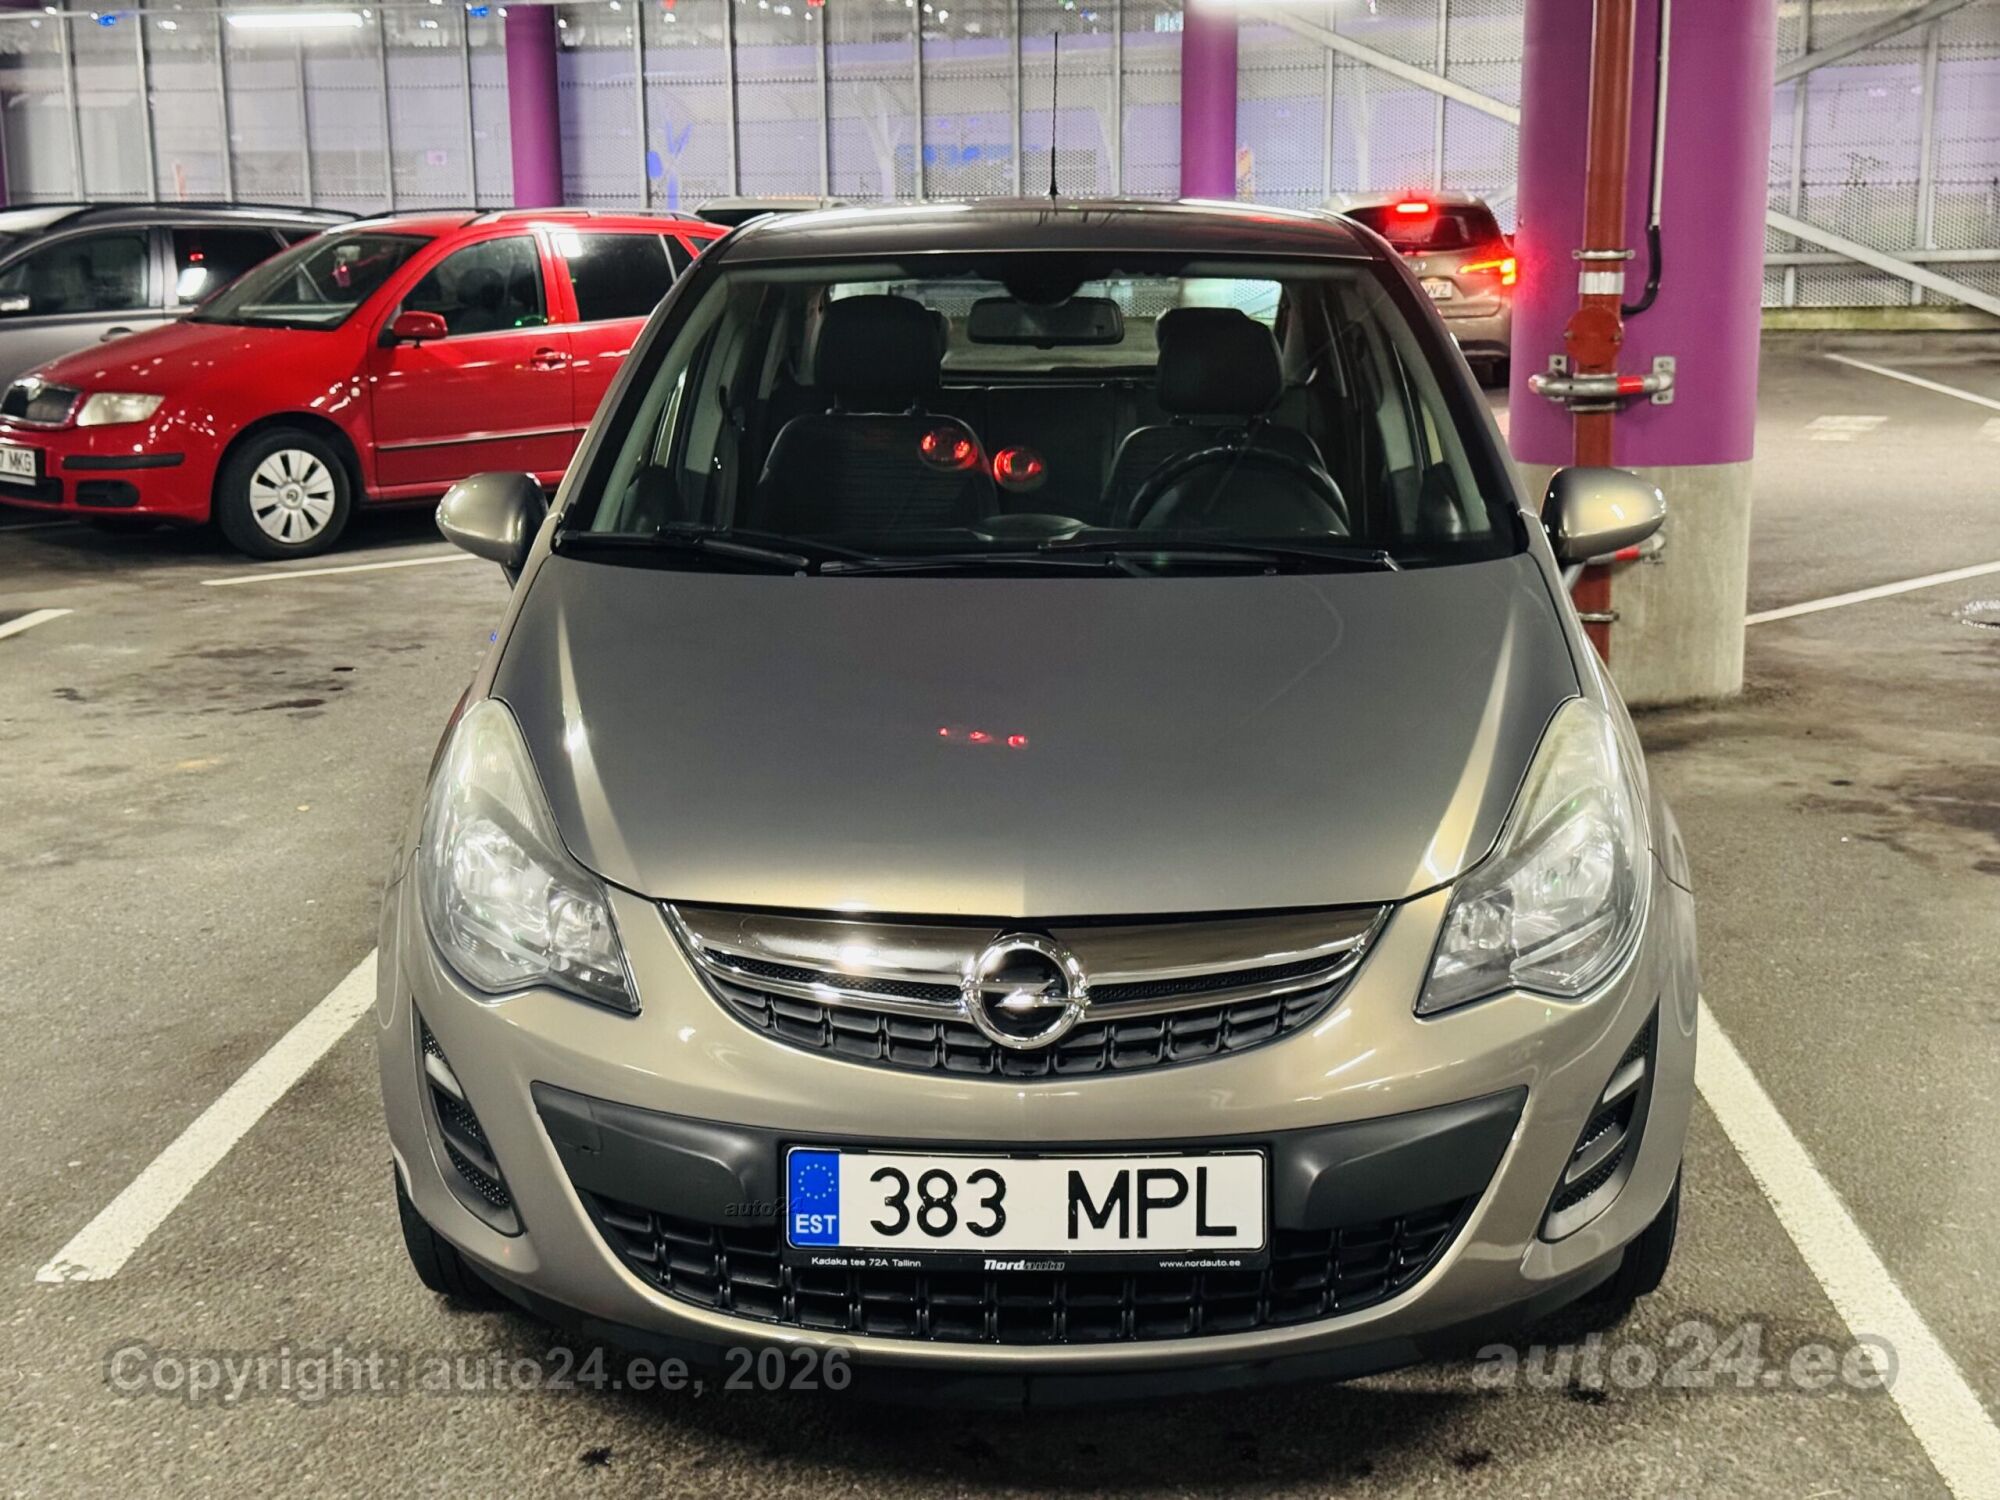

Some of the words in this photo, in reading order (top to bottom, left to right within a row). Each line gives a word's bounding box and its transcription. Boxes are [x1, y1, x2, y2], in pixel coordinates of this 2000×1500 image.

[869, 1167, 1007, 1237] 383
[1067, 1166, 1237, 1239] MPL
[795, 1213, 837, 1235] EST
[811, 1257, 847, 1266] Kadaka
[850, 1258, 866, 1266] tee
[869, 1258, 888, 1267] 72A
[892, 1258, 921, 1267] Tallinn
[1159, 1259, 1241, 1268] www.nordauto.ee
